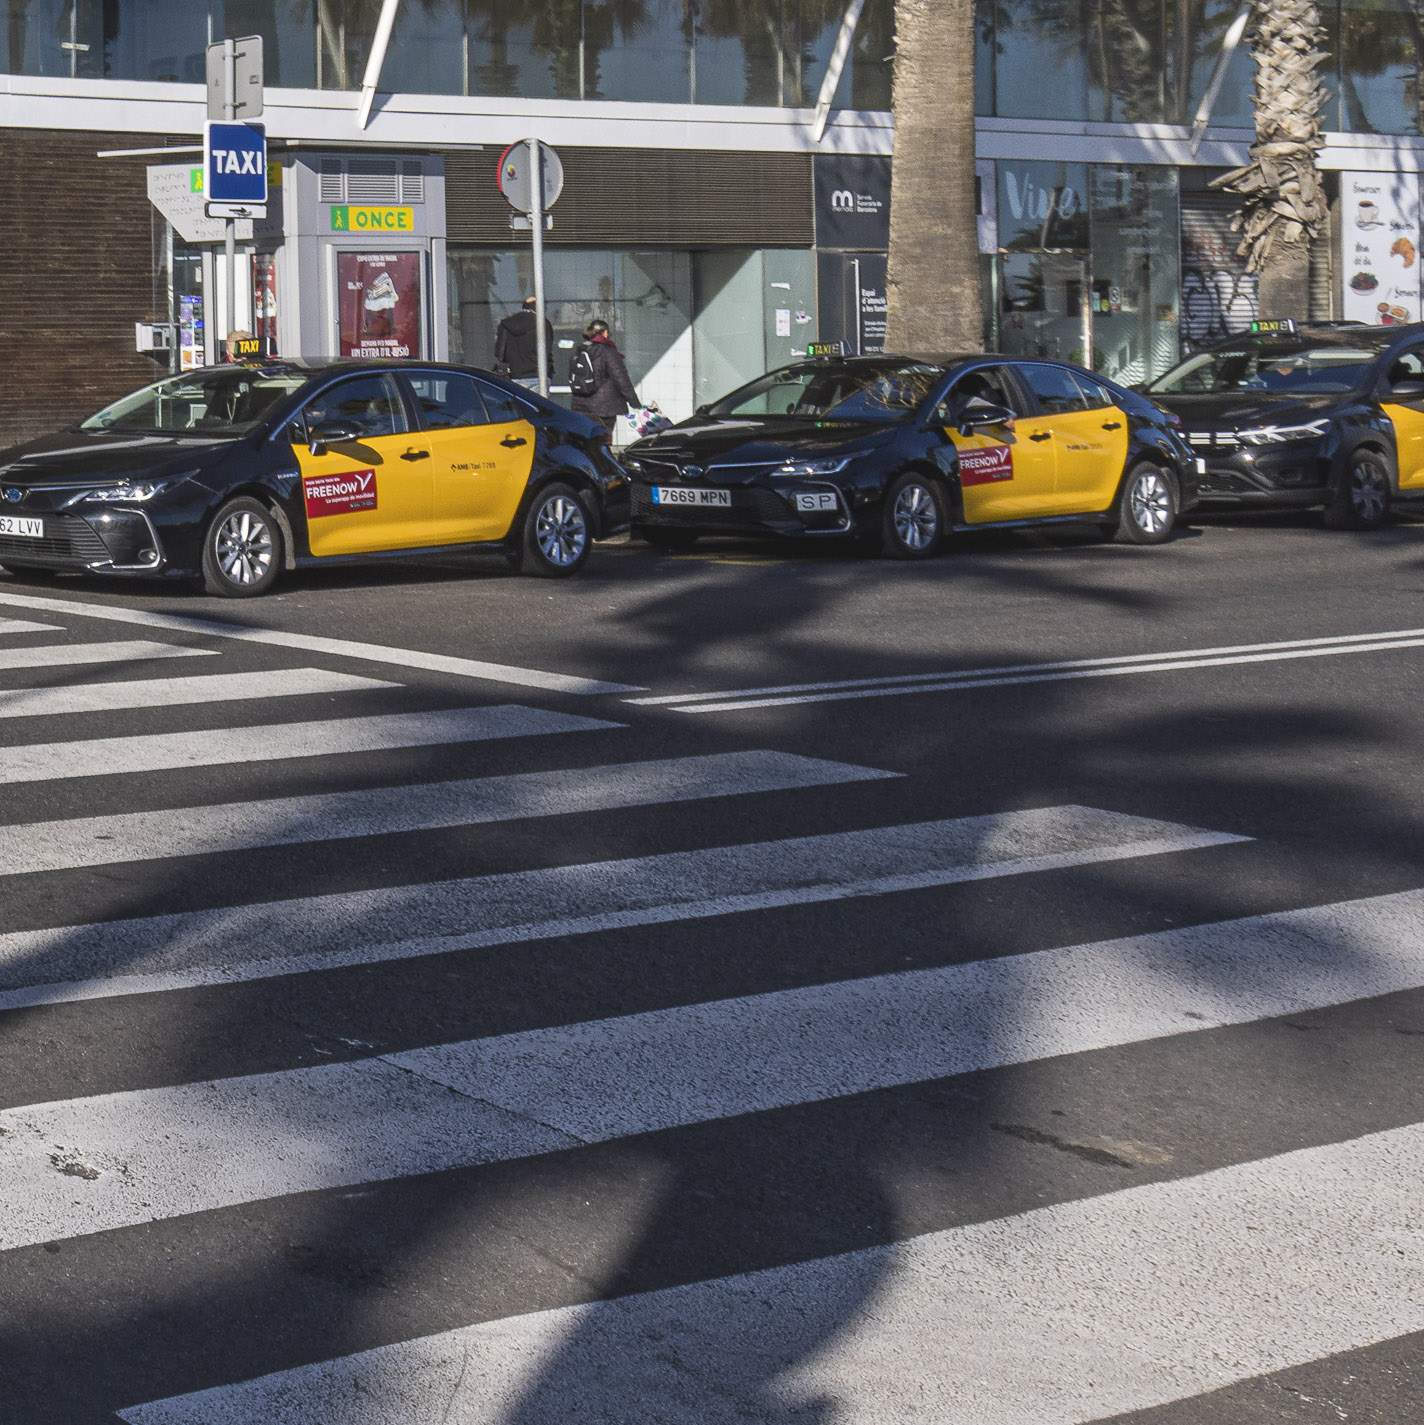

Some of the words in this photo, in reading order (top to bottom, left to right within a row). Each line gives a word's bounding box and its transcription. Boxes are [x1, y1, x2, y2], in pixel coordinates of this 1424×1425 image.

[212, 149, 263, 175] TAXI
[355, 211, 407, 229] ONCE
[1259, 321, 1279, 332] TAXI
[239, 339, 260, 353] TAXI
[814, 344, 832, 355] TAXI
[960, 455, 999, 470] FREENOW
[306, 481, 358, 500] FREENOW
[661, 489, 696, 503] 7669
[700, 491, 728, 505] MPN
[18, 519, 41, 535] LVV
